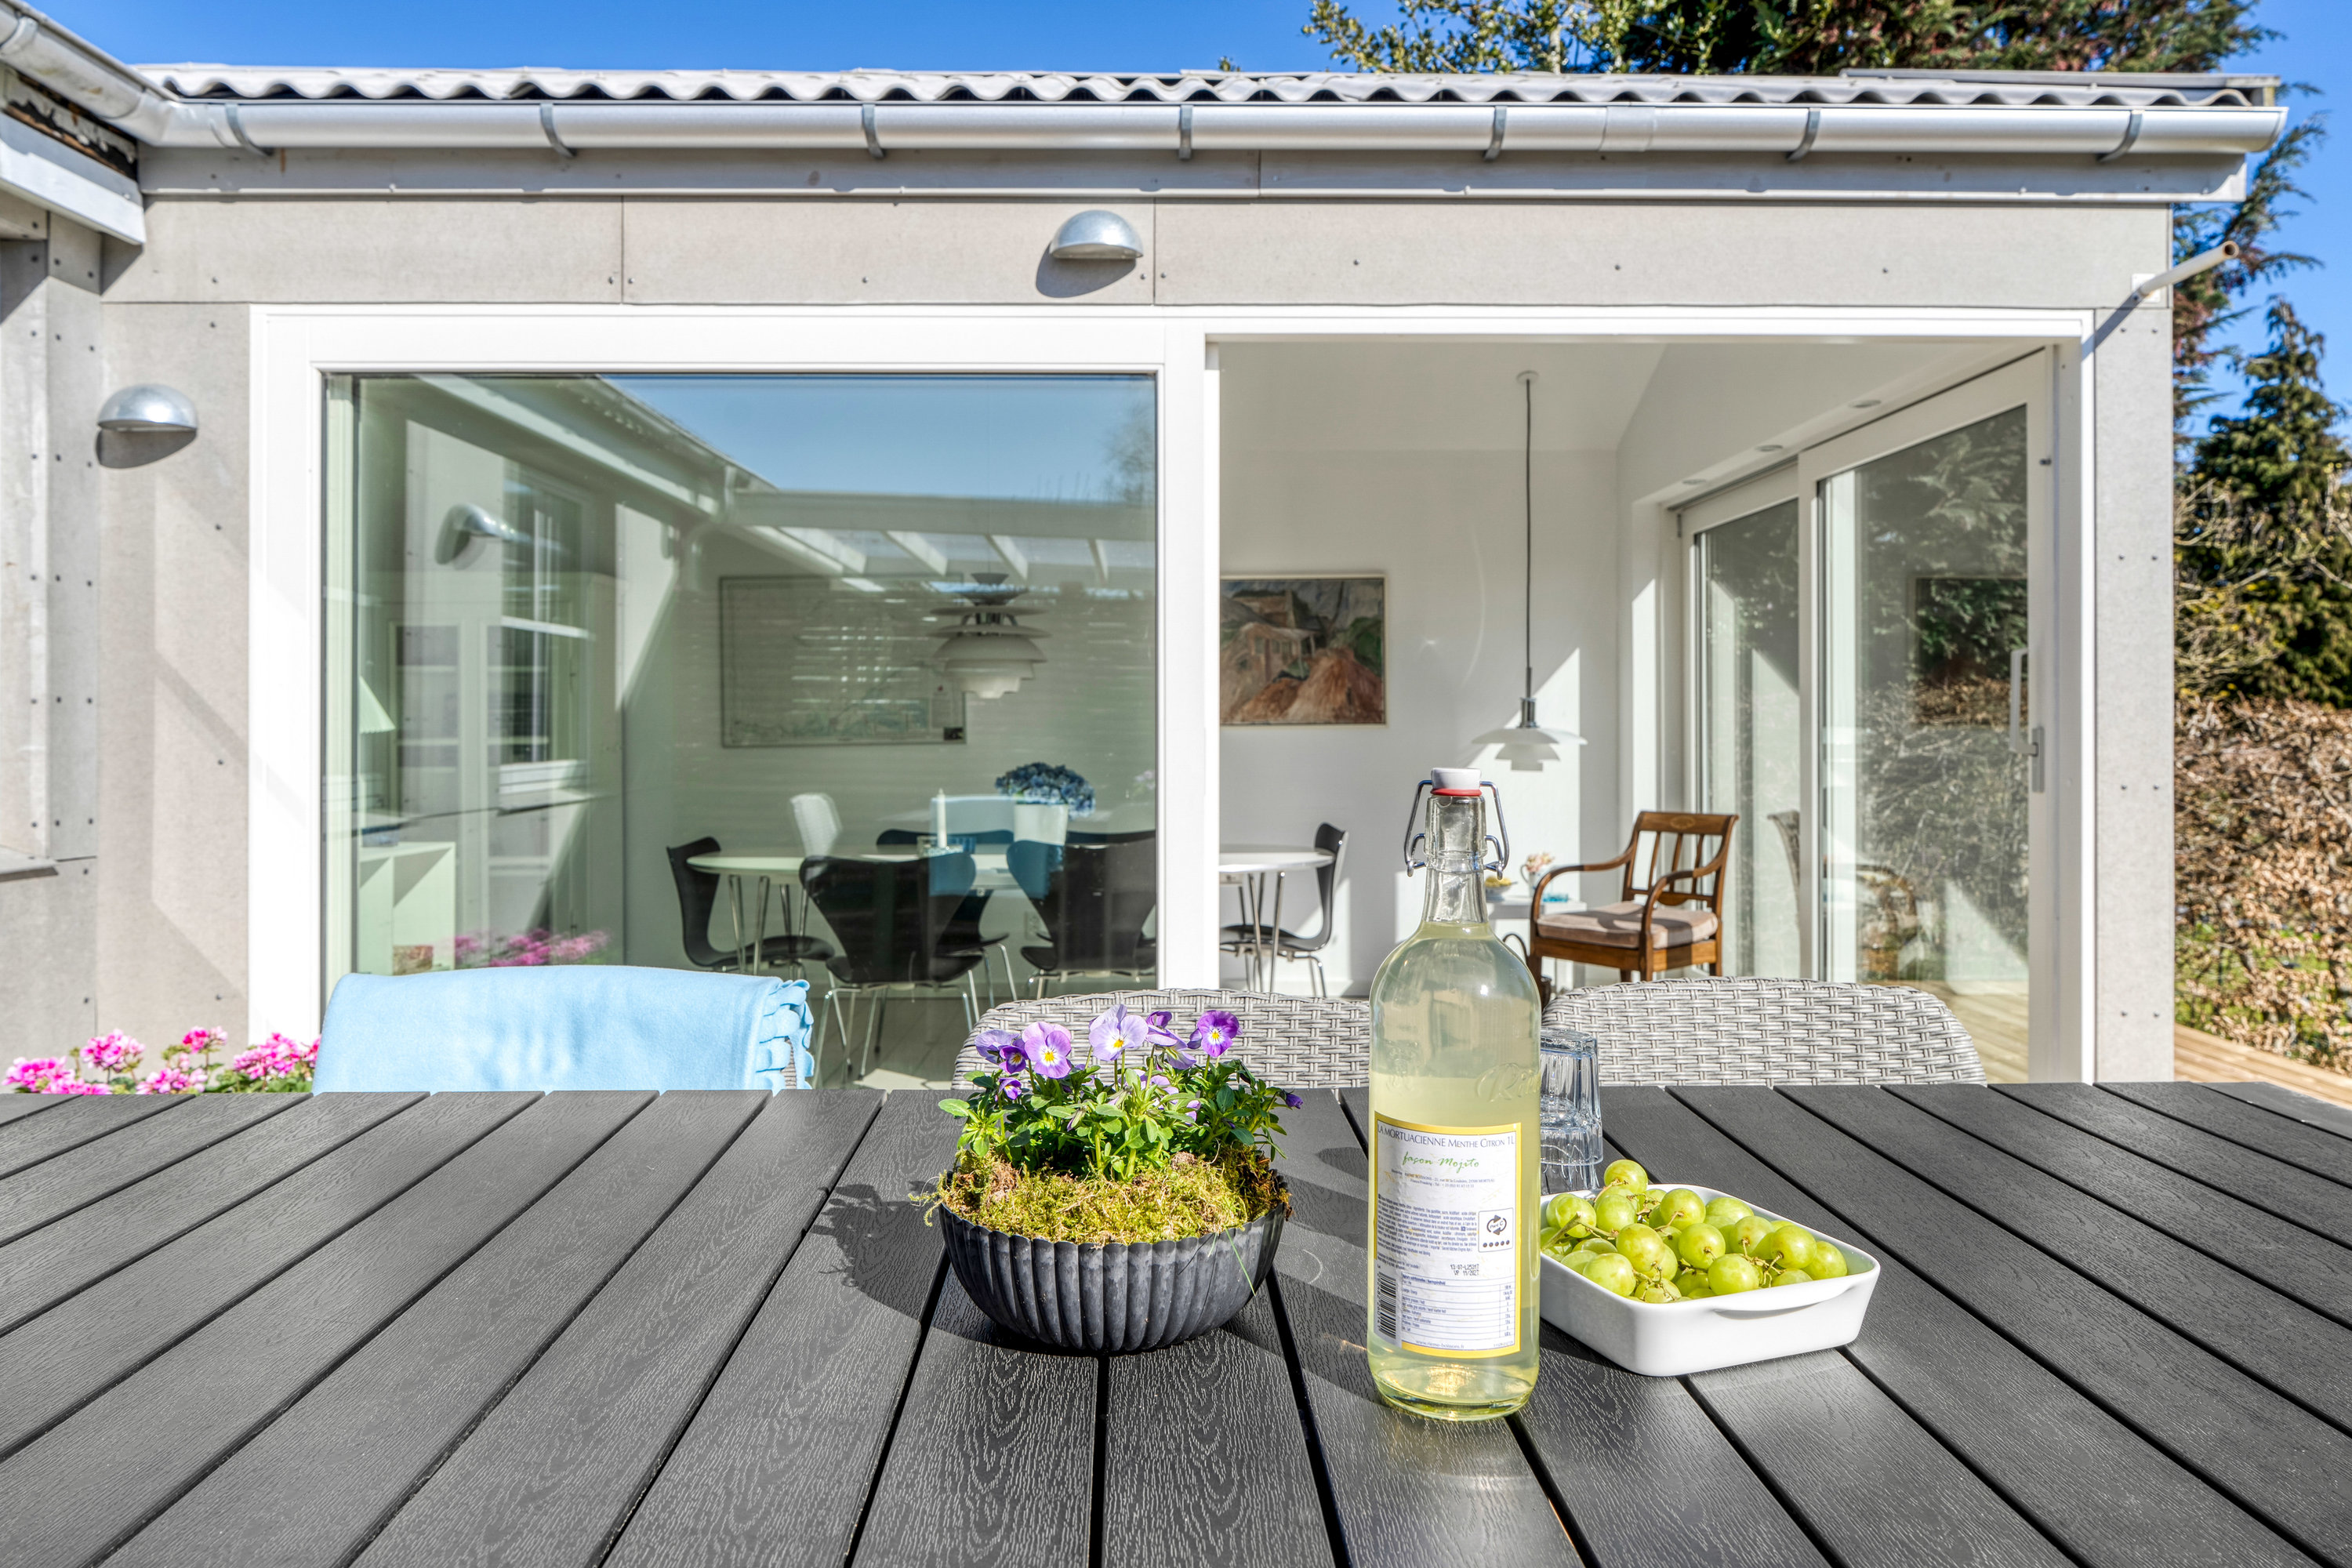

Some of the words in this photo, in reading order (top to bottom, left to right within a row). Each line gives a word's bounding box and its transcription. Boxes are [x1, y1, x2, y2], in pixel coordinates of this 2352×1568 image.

[1377, 1123, 1384, 1134] LA
[1385, 1127, 1446, 1147] MORTUACIENNE
[1439, 1157, 1479, 1174] Mojito
